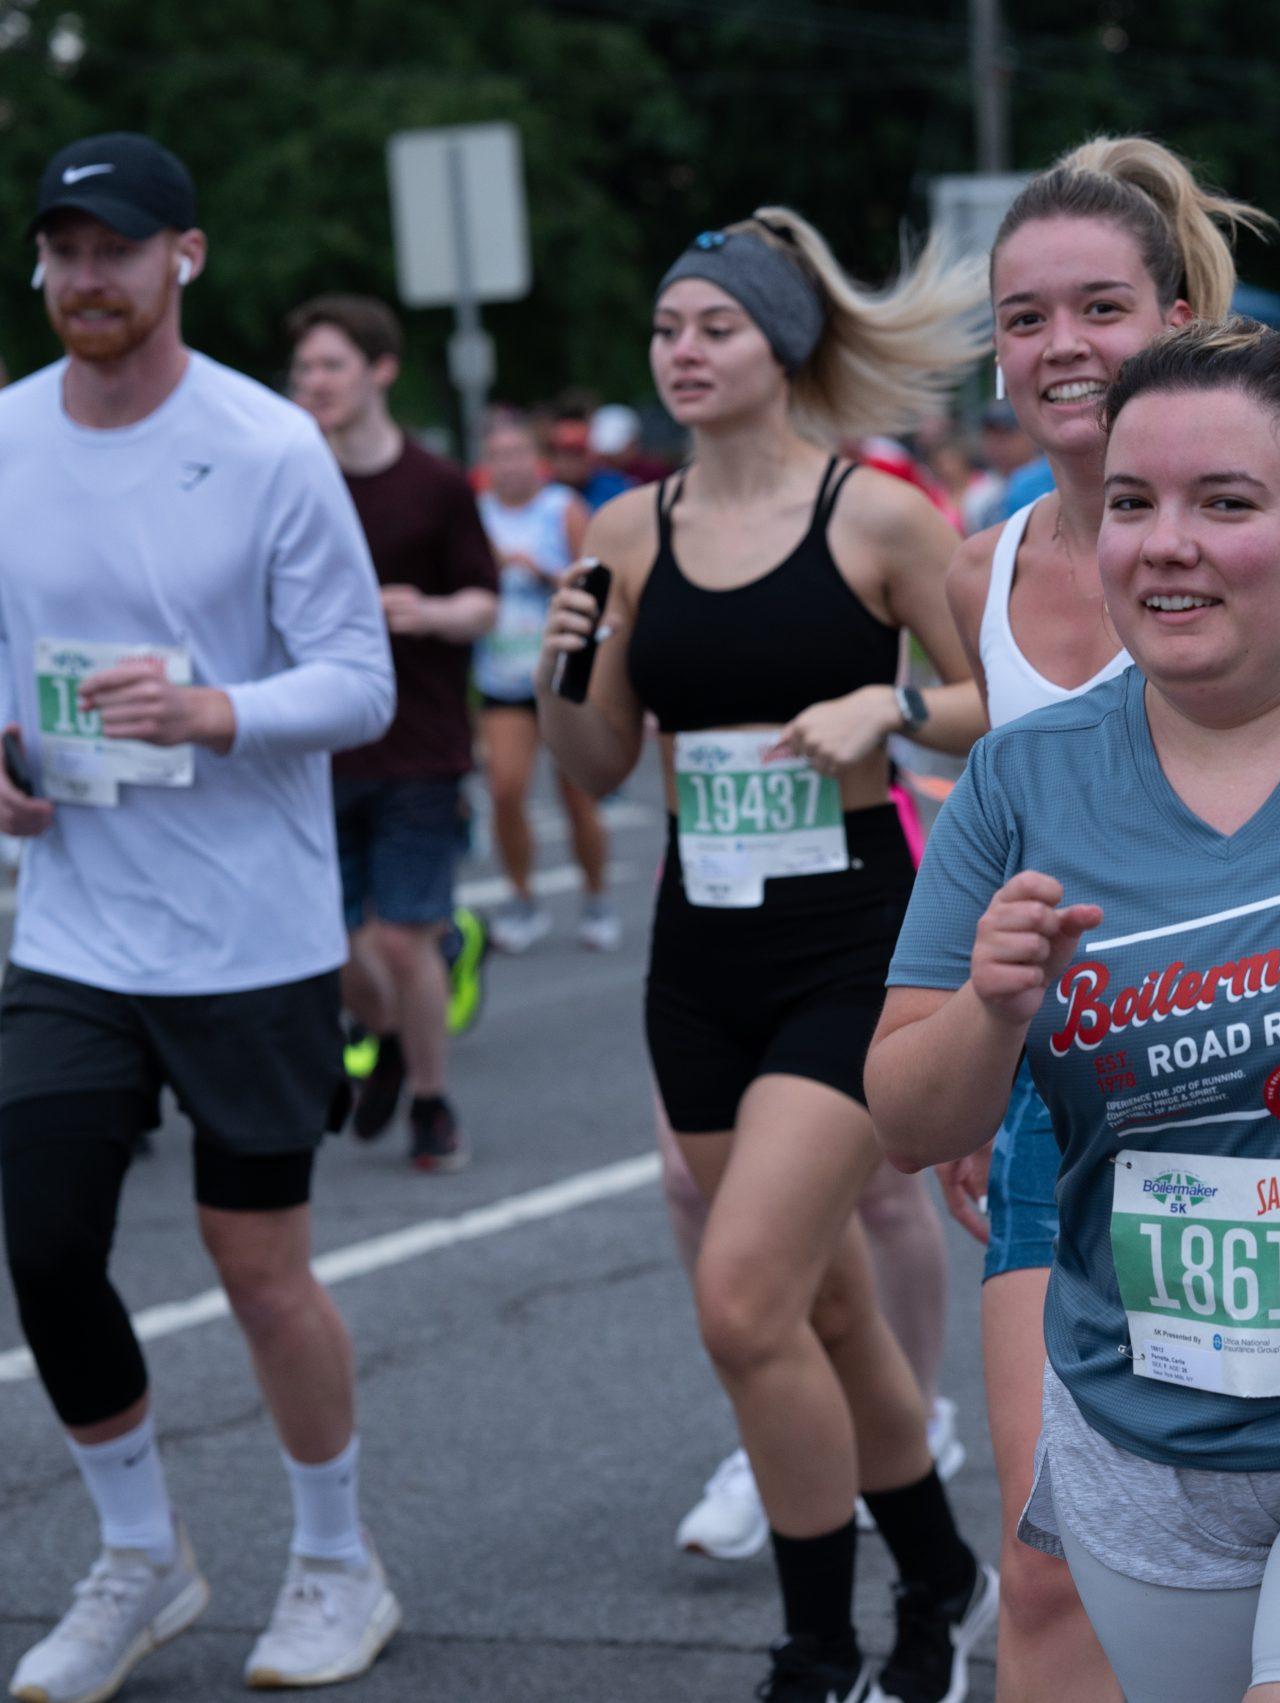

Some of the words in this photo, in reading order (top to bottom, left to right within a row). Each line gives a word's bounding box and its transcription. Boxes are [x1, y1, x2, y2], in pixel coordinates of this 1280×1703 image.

[689, 771, 821, 832] 19437
[1147, 1022, 1251, 1077] ROAD
[1097, 1072, 1137, 1094] 1978
[1152, 1089, 1170, 1100] THE
[1172, 1084, 1187, 1095] JOY
[1188, 1081, 1201, 1091] OF
[1153, 1096, 1178, 1107] PRIDE
[1143, 1179, 1218, 1197] Boilermaker
[1170, 1203, 1187, 1214] 5K
[1241, 1338, 1271, 1346] National
